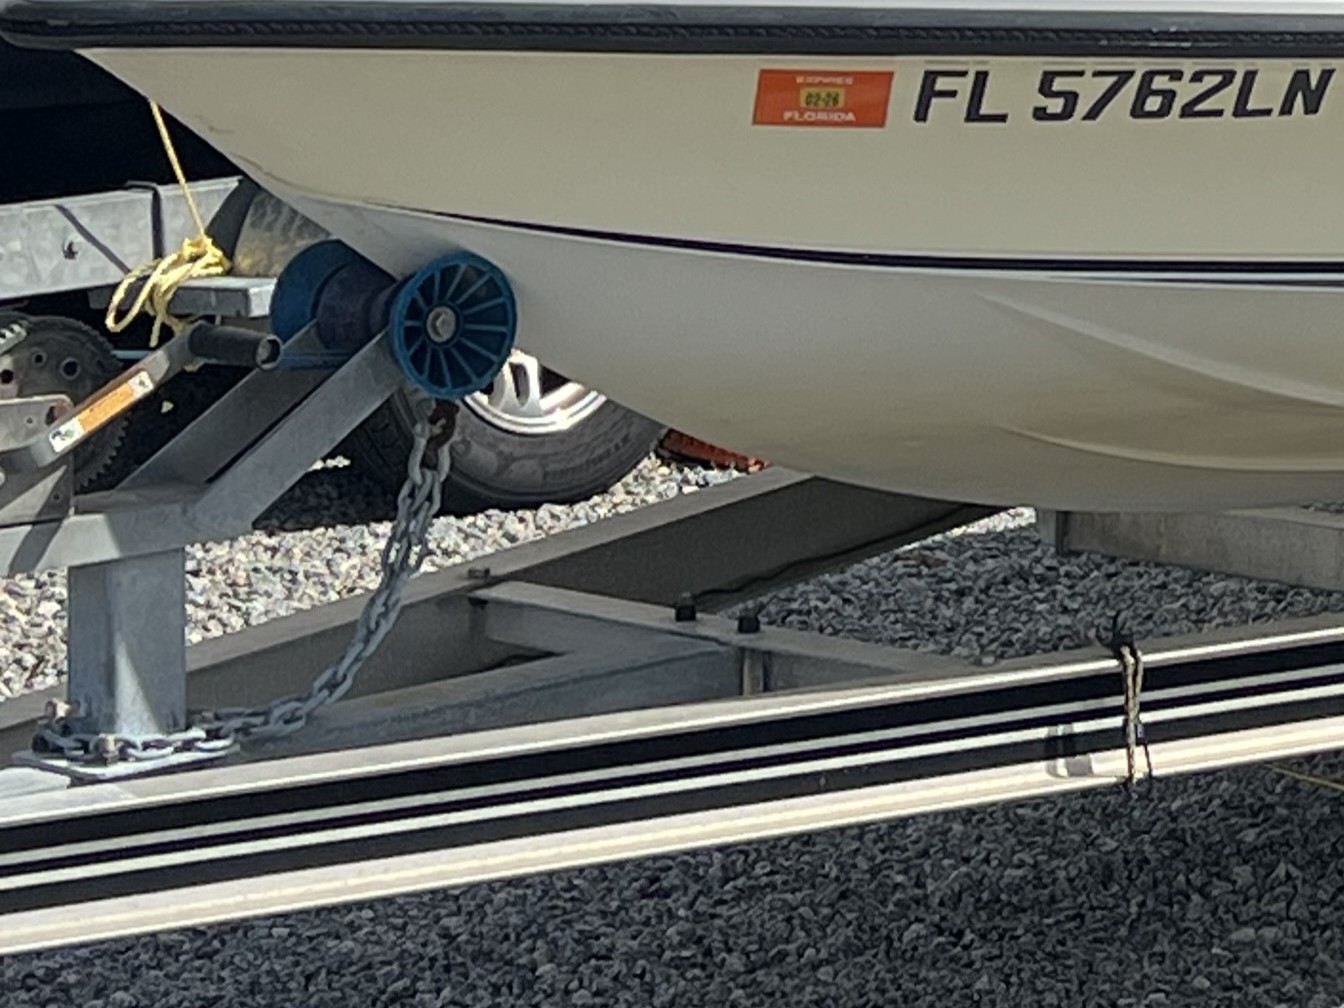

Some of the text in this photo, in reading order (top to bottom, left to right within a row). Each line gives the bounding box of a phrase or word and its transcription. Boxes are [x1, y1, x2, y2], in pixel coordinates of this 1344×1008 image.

[913, 67, 1336, 123] FL 5762LN
[783, 109, 857, 122] FLORIDA
